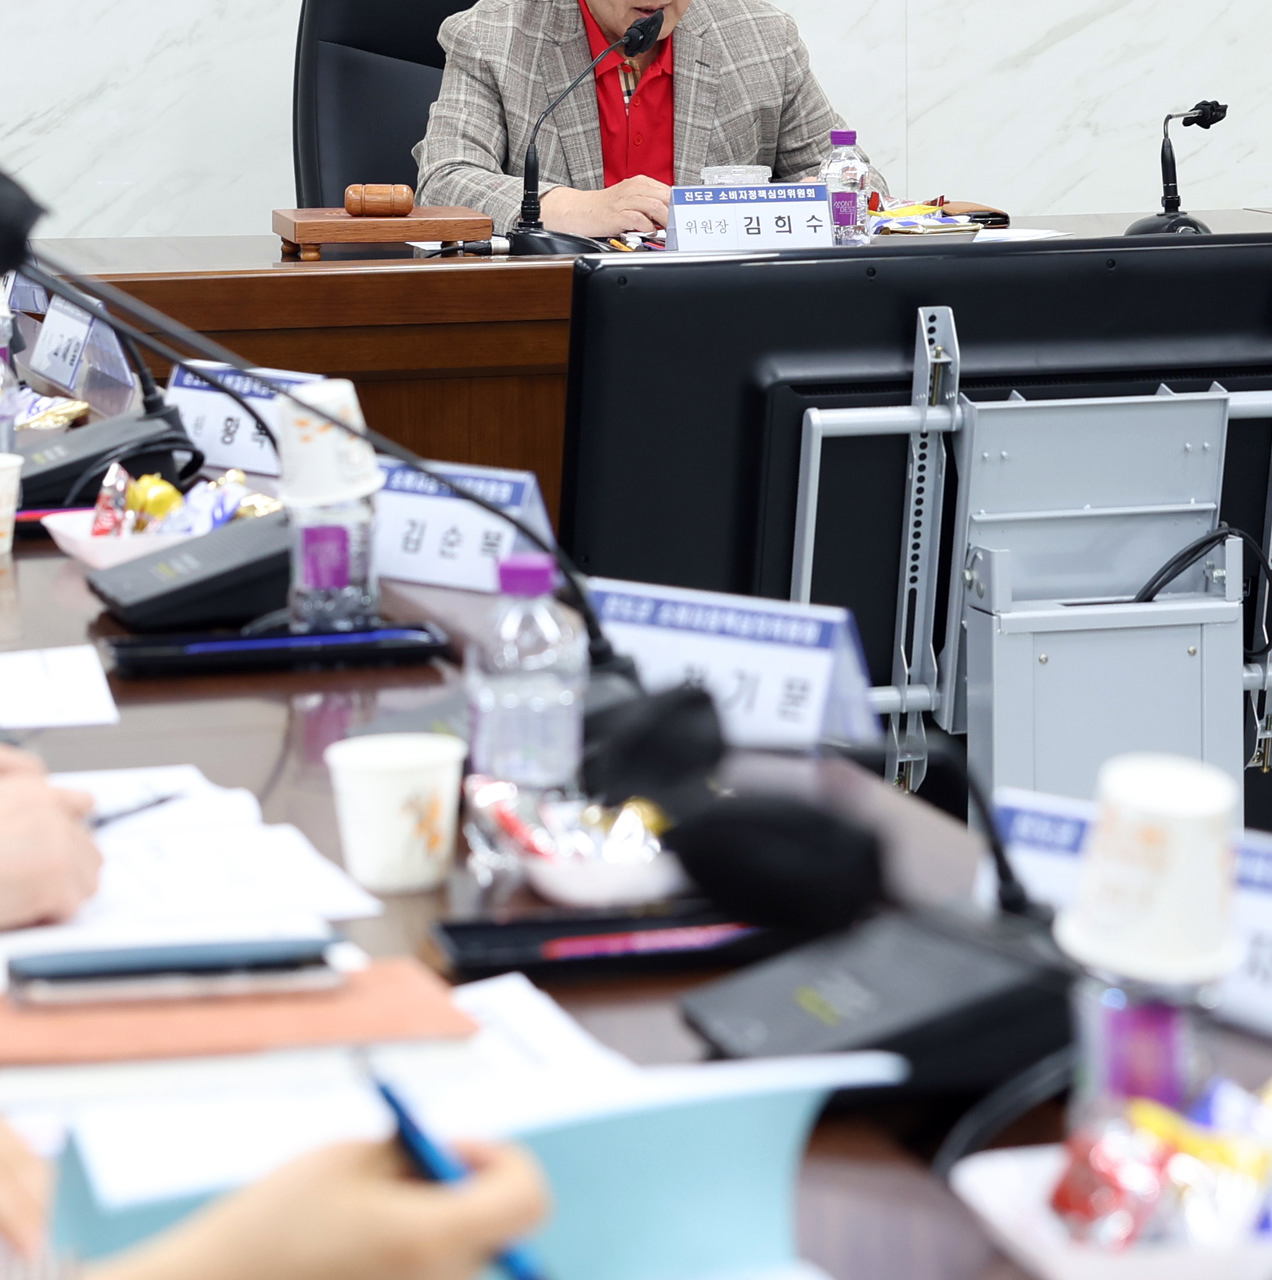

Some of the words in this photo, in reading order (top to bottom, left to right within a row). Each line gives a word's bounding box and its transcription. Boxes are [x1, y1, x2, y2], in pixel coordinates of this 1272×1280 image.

[684, 191, 714, 202] 진도군
[718, 188, 816, 200] 소비자정책심의위원회
[685, 219, 729, 235] 위원장
